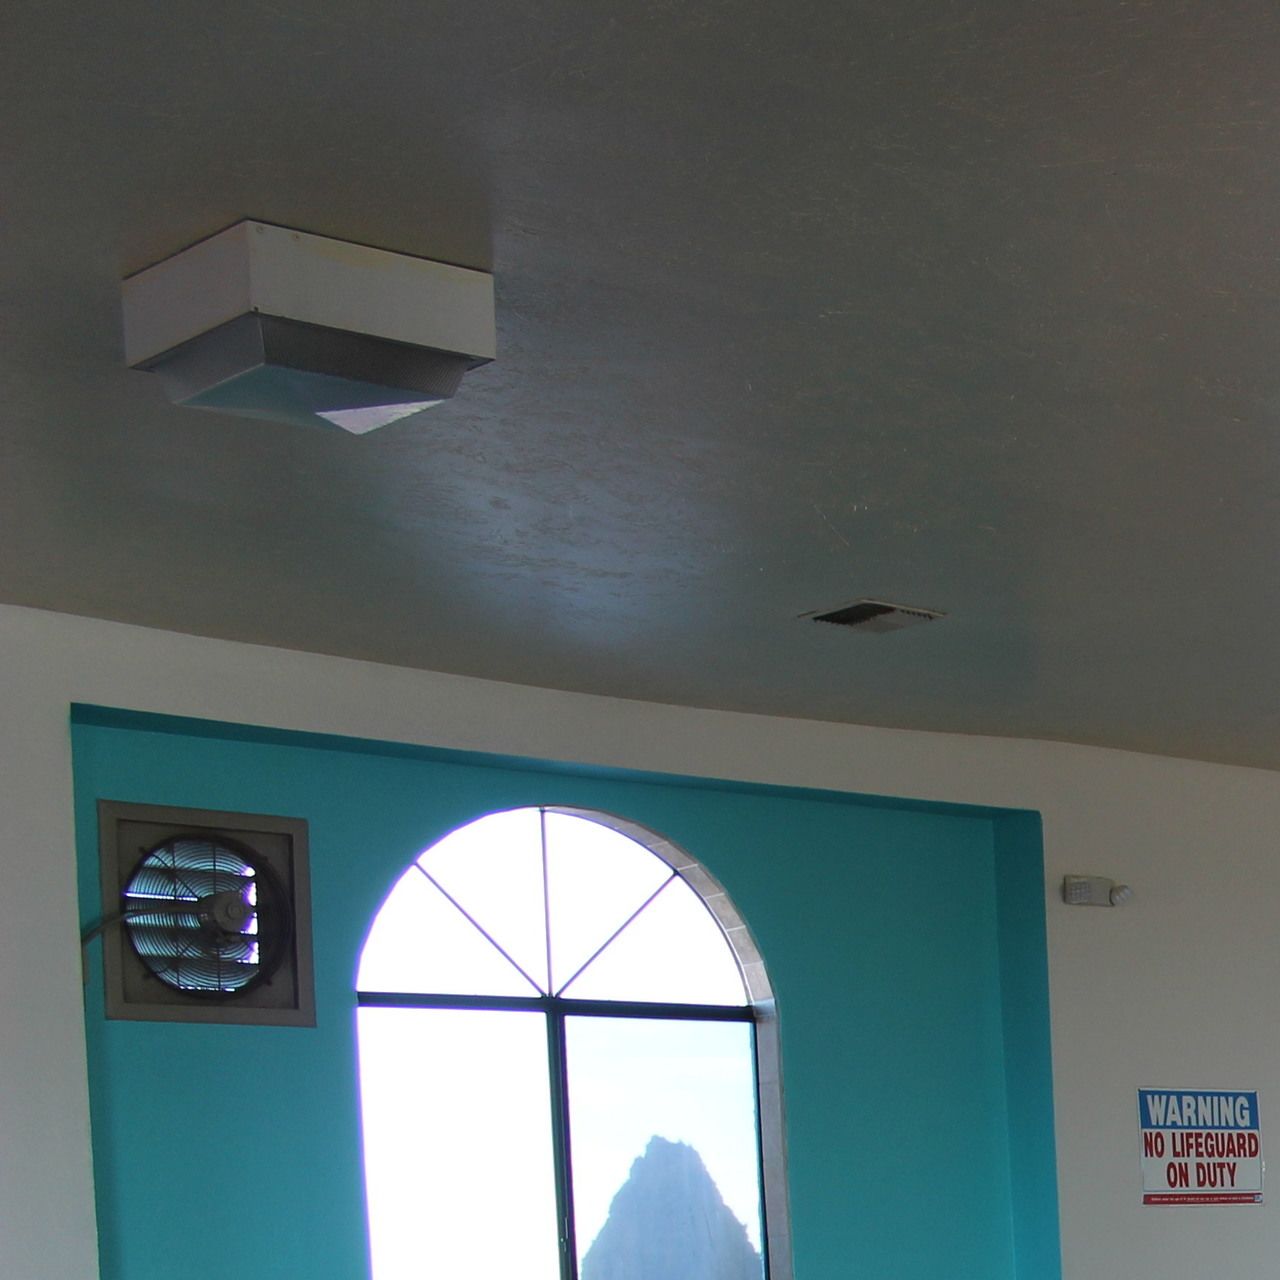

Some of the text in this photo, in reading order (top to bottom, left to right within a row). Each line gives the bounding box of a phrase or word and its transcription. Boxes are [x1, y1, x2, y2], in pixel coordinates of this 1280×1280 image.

[1146, 1094, 1250, 1127] WARNING
[1143, 1131, 1259, 1158] NO LIFEGUARD
[1166, 1161, 1236, 1188] ON DUTY
